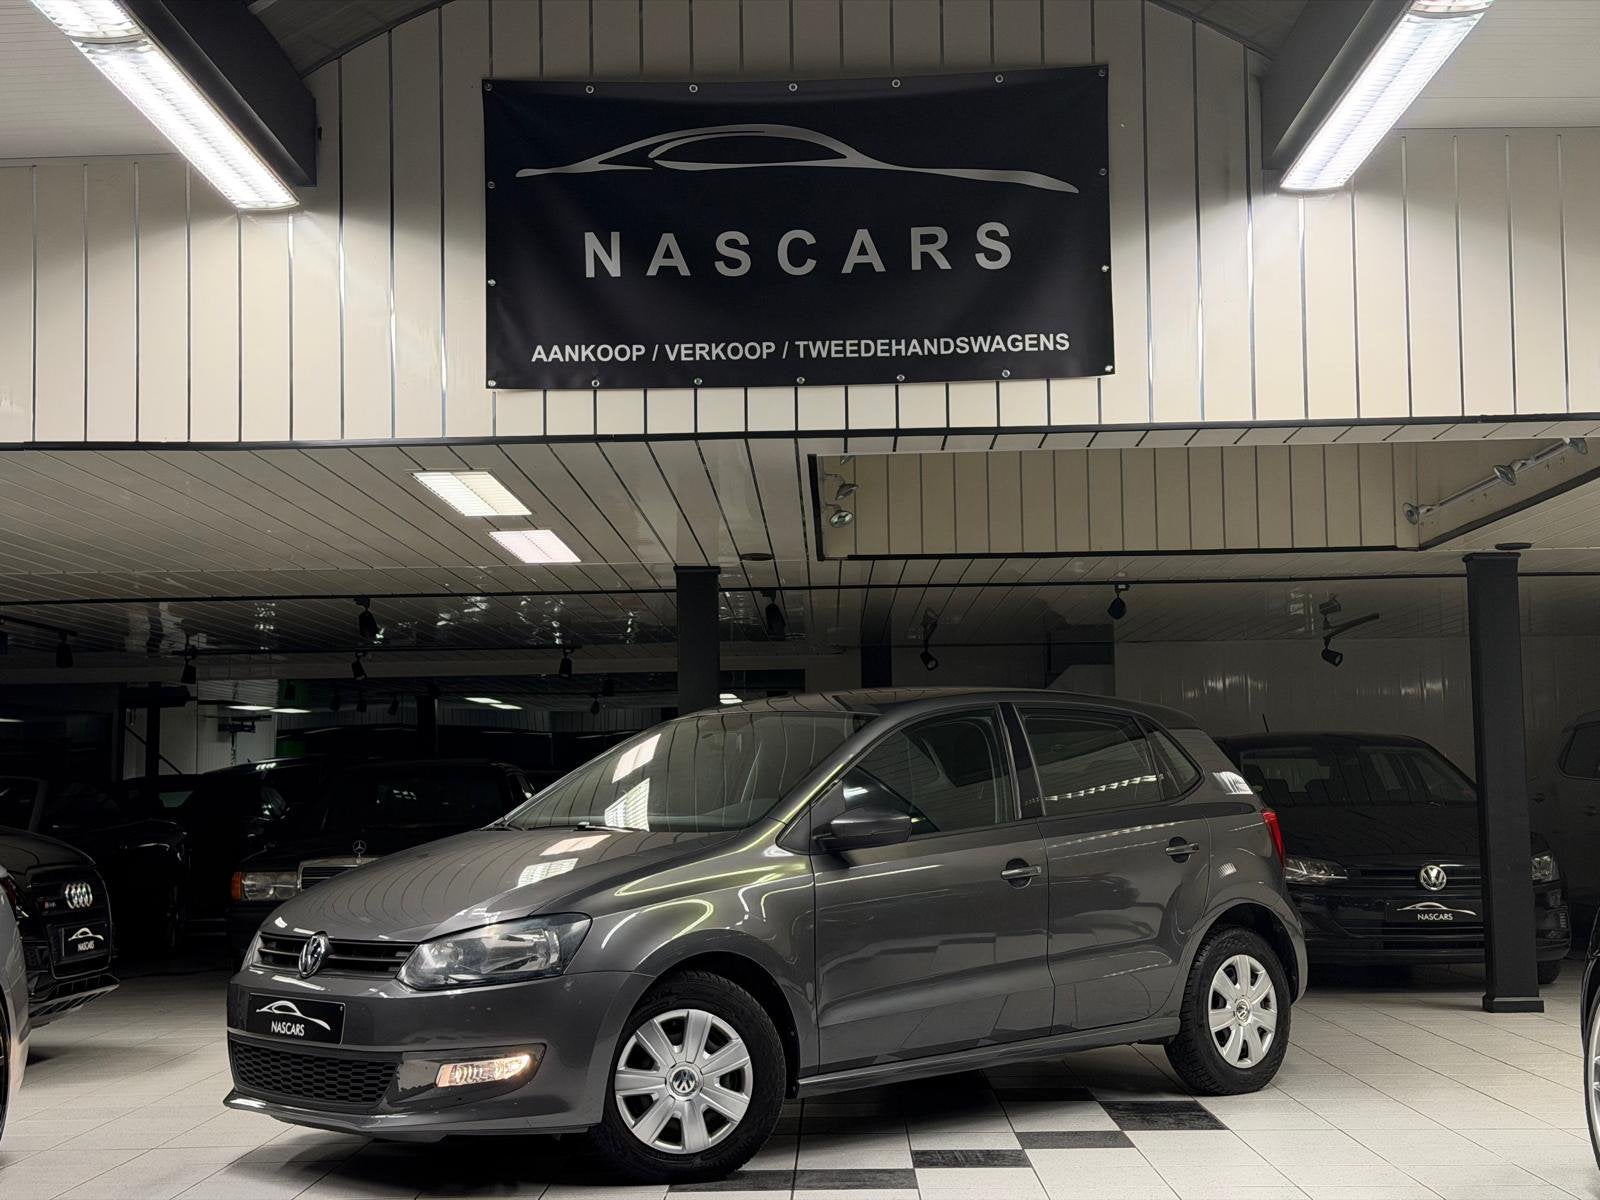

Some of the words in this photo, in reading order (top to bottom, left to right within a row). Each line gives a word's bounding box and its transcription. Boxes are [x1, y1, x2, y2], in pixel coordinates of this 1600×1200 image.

[584, 222, 1012, 278] NASCARS
[531, 343, 646, 363] AANKOOP
[664, 341, 776, 362] VERKOOP
[795, 332, 1070, 359] TWEEDEHANDSWAGENS
[1417, 912, 1454, 921] NASCARS
[271, 1020, 305, 1037] NASCARS
